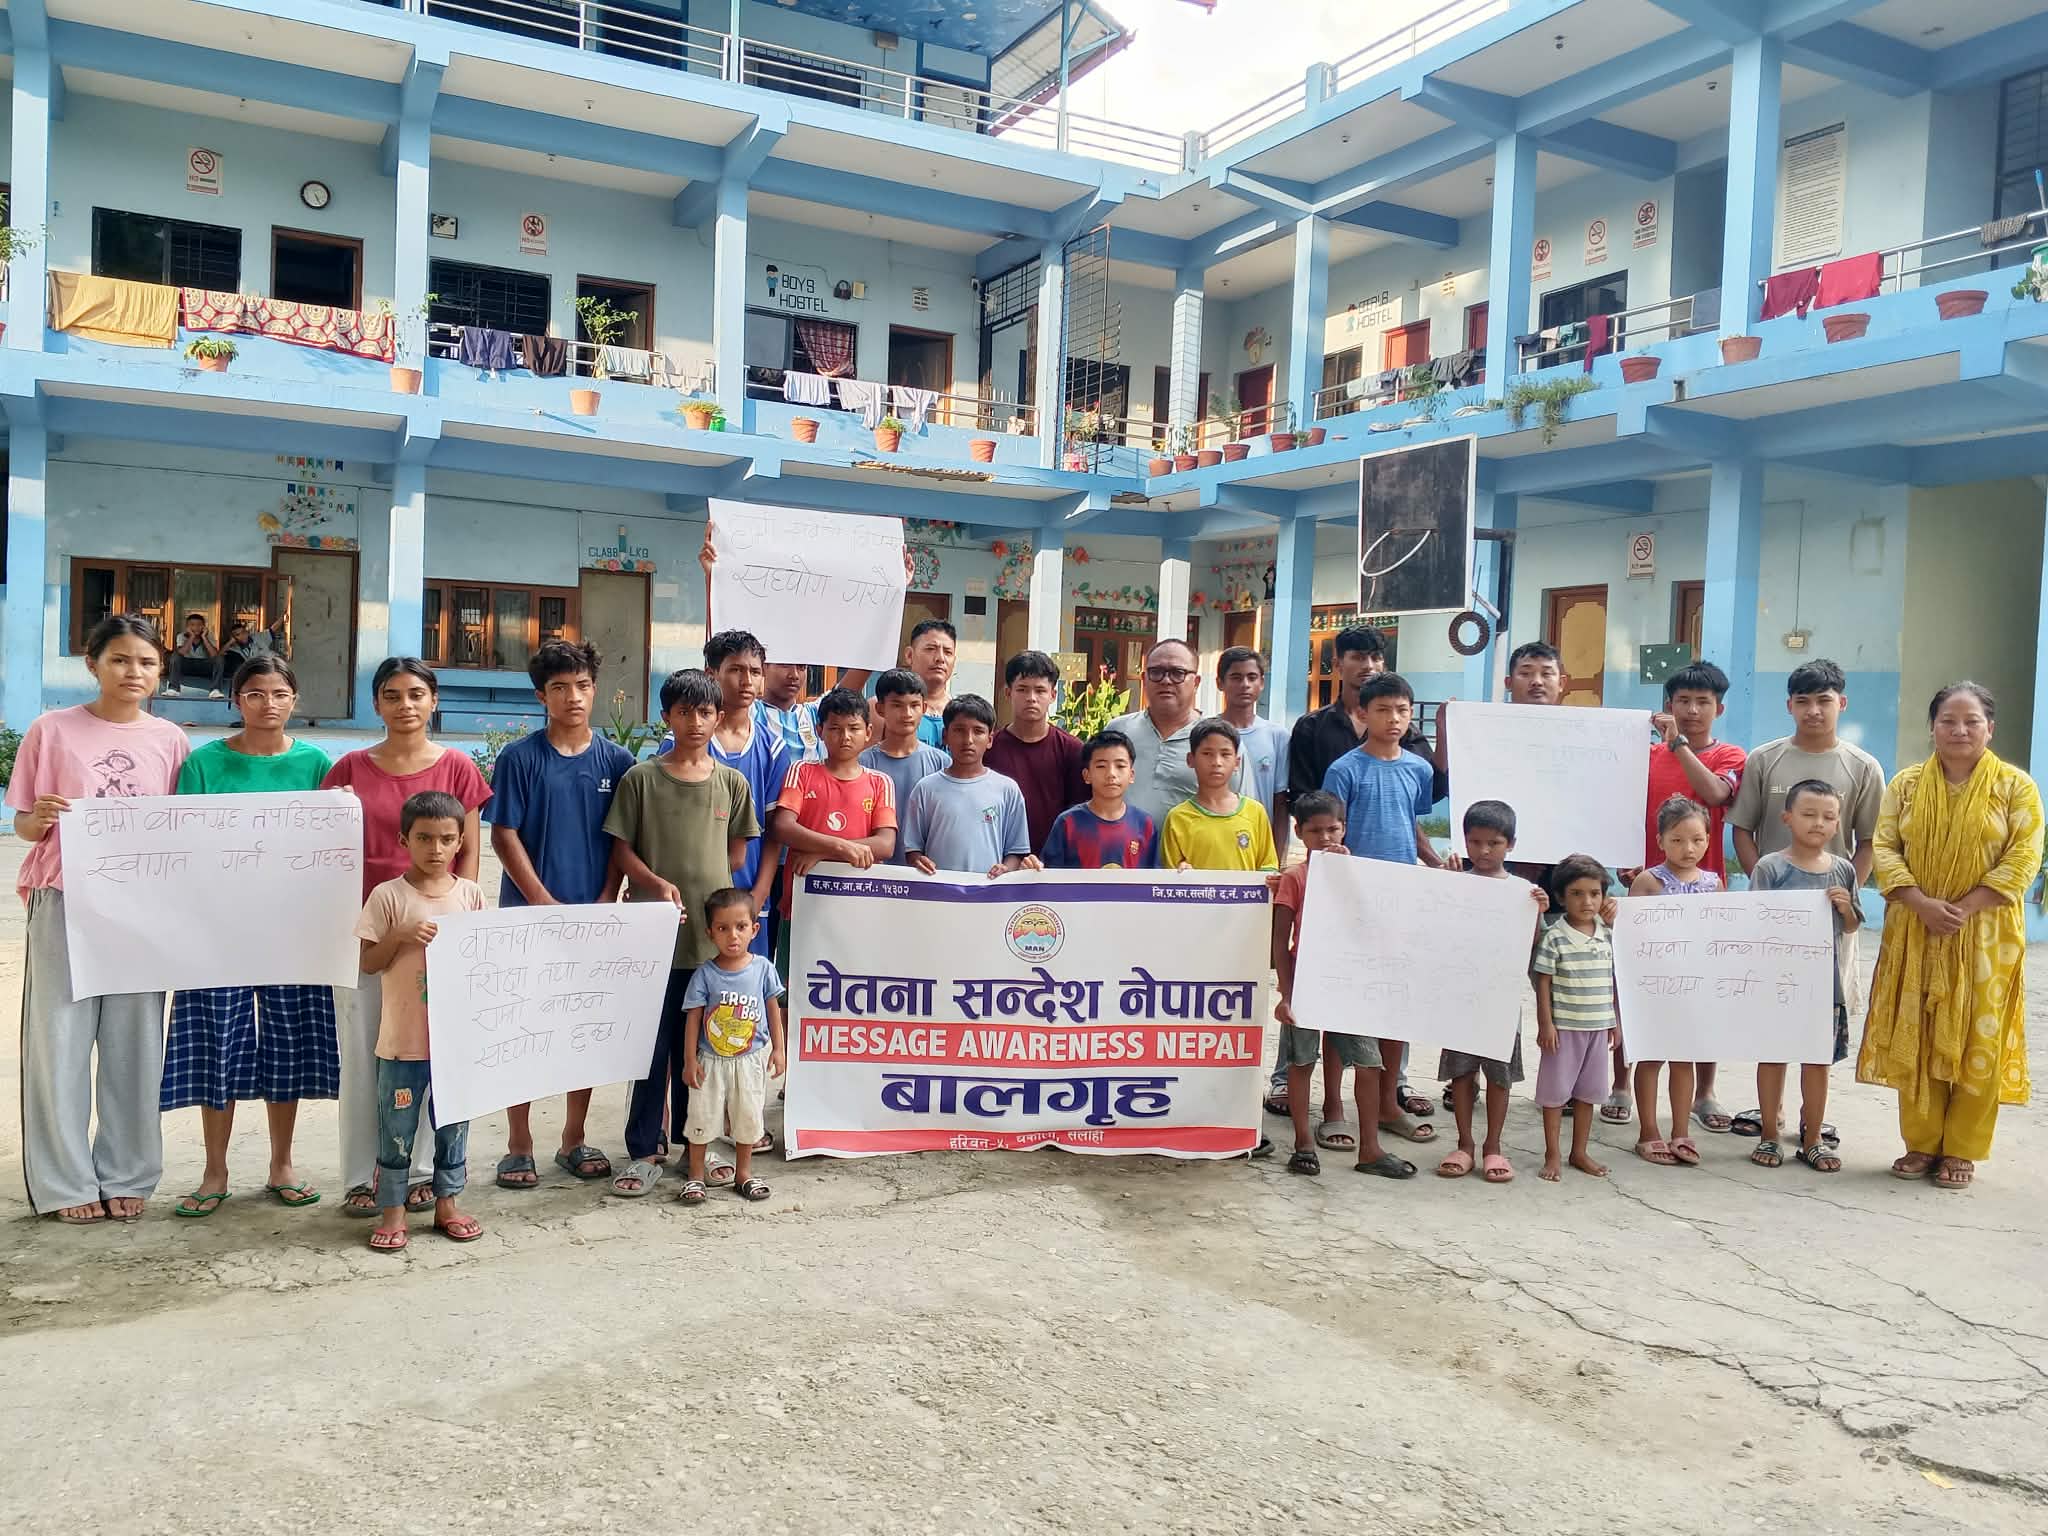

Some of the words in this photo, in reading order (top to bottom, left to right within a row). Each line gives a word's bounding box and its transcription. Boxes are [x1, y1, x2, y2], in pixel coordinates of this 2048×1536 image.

[779, 294, 828, 312] HOSTEL
[782, 274, 815, 293] BOYS
[87, 850, 192, 882] स्वागत
[216, 840, 267, 870] गर्न
[806, 959, 938, 1016] चेतना
[952, 966, 1104, 1024] सन्देश
[1119, 966, 1258, 1022] नेपाल
[804, 1025, 946, 1058] MESSAGE
[957, 1029, 1145, 1062] AWARENESS
[1156, 1031, 1255, 1061] NEPAL
[880, 1073, 1179, 1127] बालगृह
